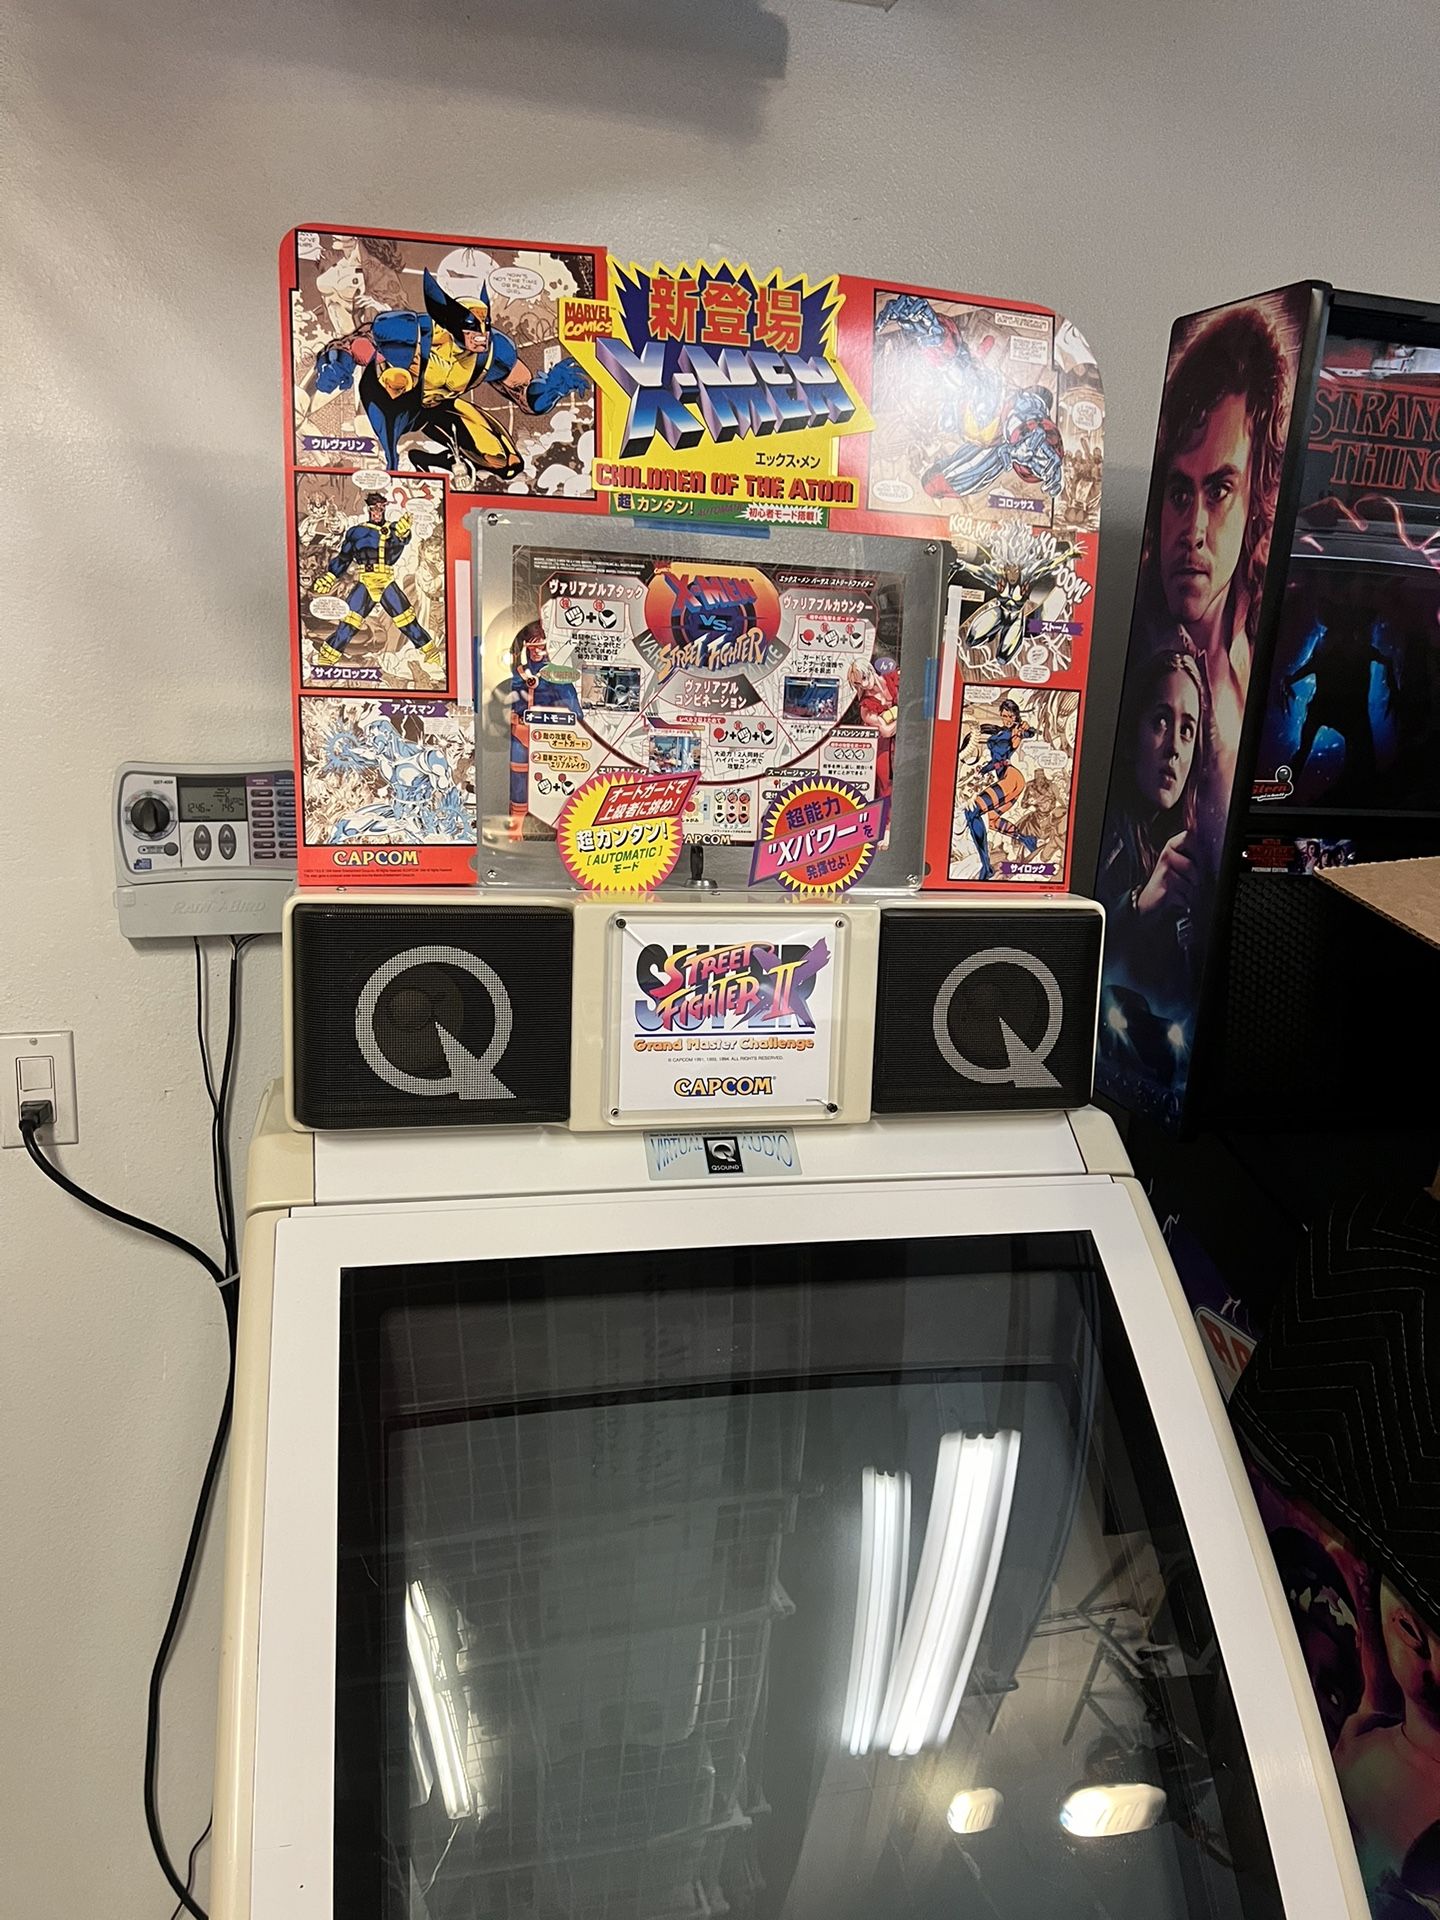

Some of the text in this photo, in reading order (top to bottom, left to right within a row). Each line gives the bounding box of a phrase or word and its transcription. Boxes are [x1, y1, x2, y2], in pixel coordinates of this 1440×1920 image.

[565, 302, 611, 321] MARVEL
[649, 275, 803, 352] 新登場
[596, 337, 856, 459] X-MEN
[311, 438, 366, 451] ウルヴァリン
[755, 452, 821, 469] エックス・メン
[596, 463, 707, 494] CHILDREN
[711, 472, 740, 495] OF
[743, 474, 785, 499] THE
[788, 478, 854, 503] ATOM
[998, 497, 1035, 510] コロッサス
[549, 579, 643, 599] ヴァリアブルアタック
[664, 573, 757, 617] X-MEN
[783, 595, 873, 614] ヴァリアブルカウンター
[1042, 622, 1069, 633] ストーム
[658, 627, 768, 682] STREET FIGHTER
[315, 668, 379, 680] サイクロップス
[685, 680, 739, 695] ヴァリアブル
[391, 703, 436, 715] アイスマン
[675, 694, 748, 710] コンビネーション
[526, 713, 574, 723] オートモード
[609, 779, 690, 803] オートガードで
[599, 797, 681, 820] 上級者に挑め!
[786, 796, 841, 829] 超能力
[576, 821, 669, 852] 超カンタン!
[682, 833, 731, 845] APCOM
[333, 850, 419, 866] CAPCOM
[613, 861, 640, 874] モード
[806, 854, 851, 880] 発揮せよ!
[1010, 863, 1047, 874] サイロック
[650, 941, 775, 998] STREET
[655, 972, 762, 1031] FIGHTER
[634, 1036, 815, 1052] Grand Master Challenge
[674, 1076, 773, 1097] CAPCOM
[650, 1134, 793, 1172] VIRTUAL AUDIO
